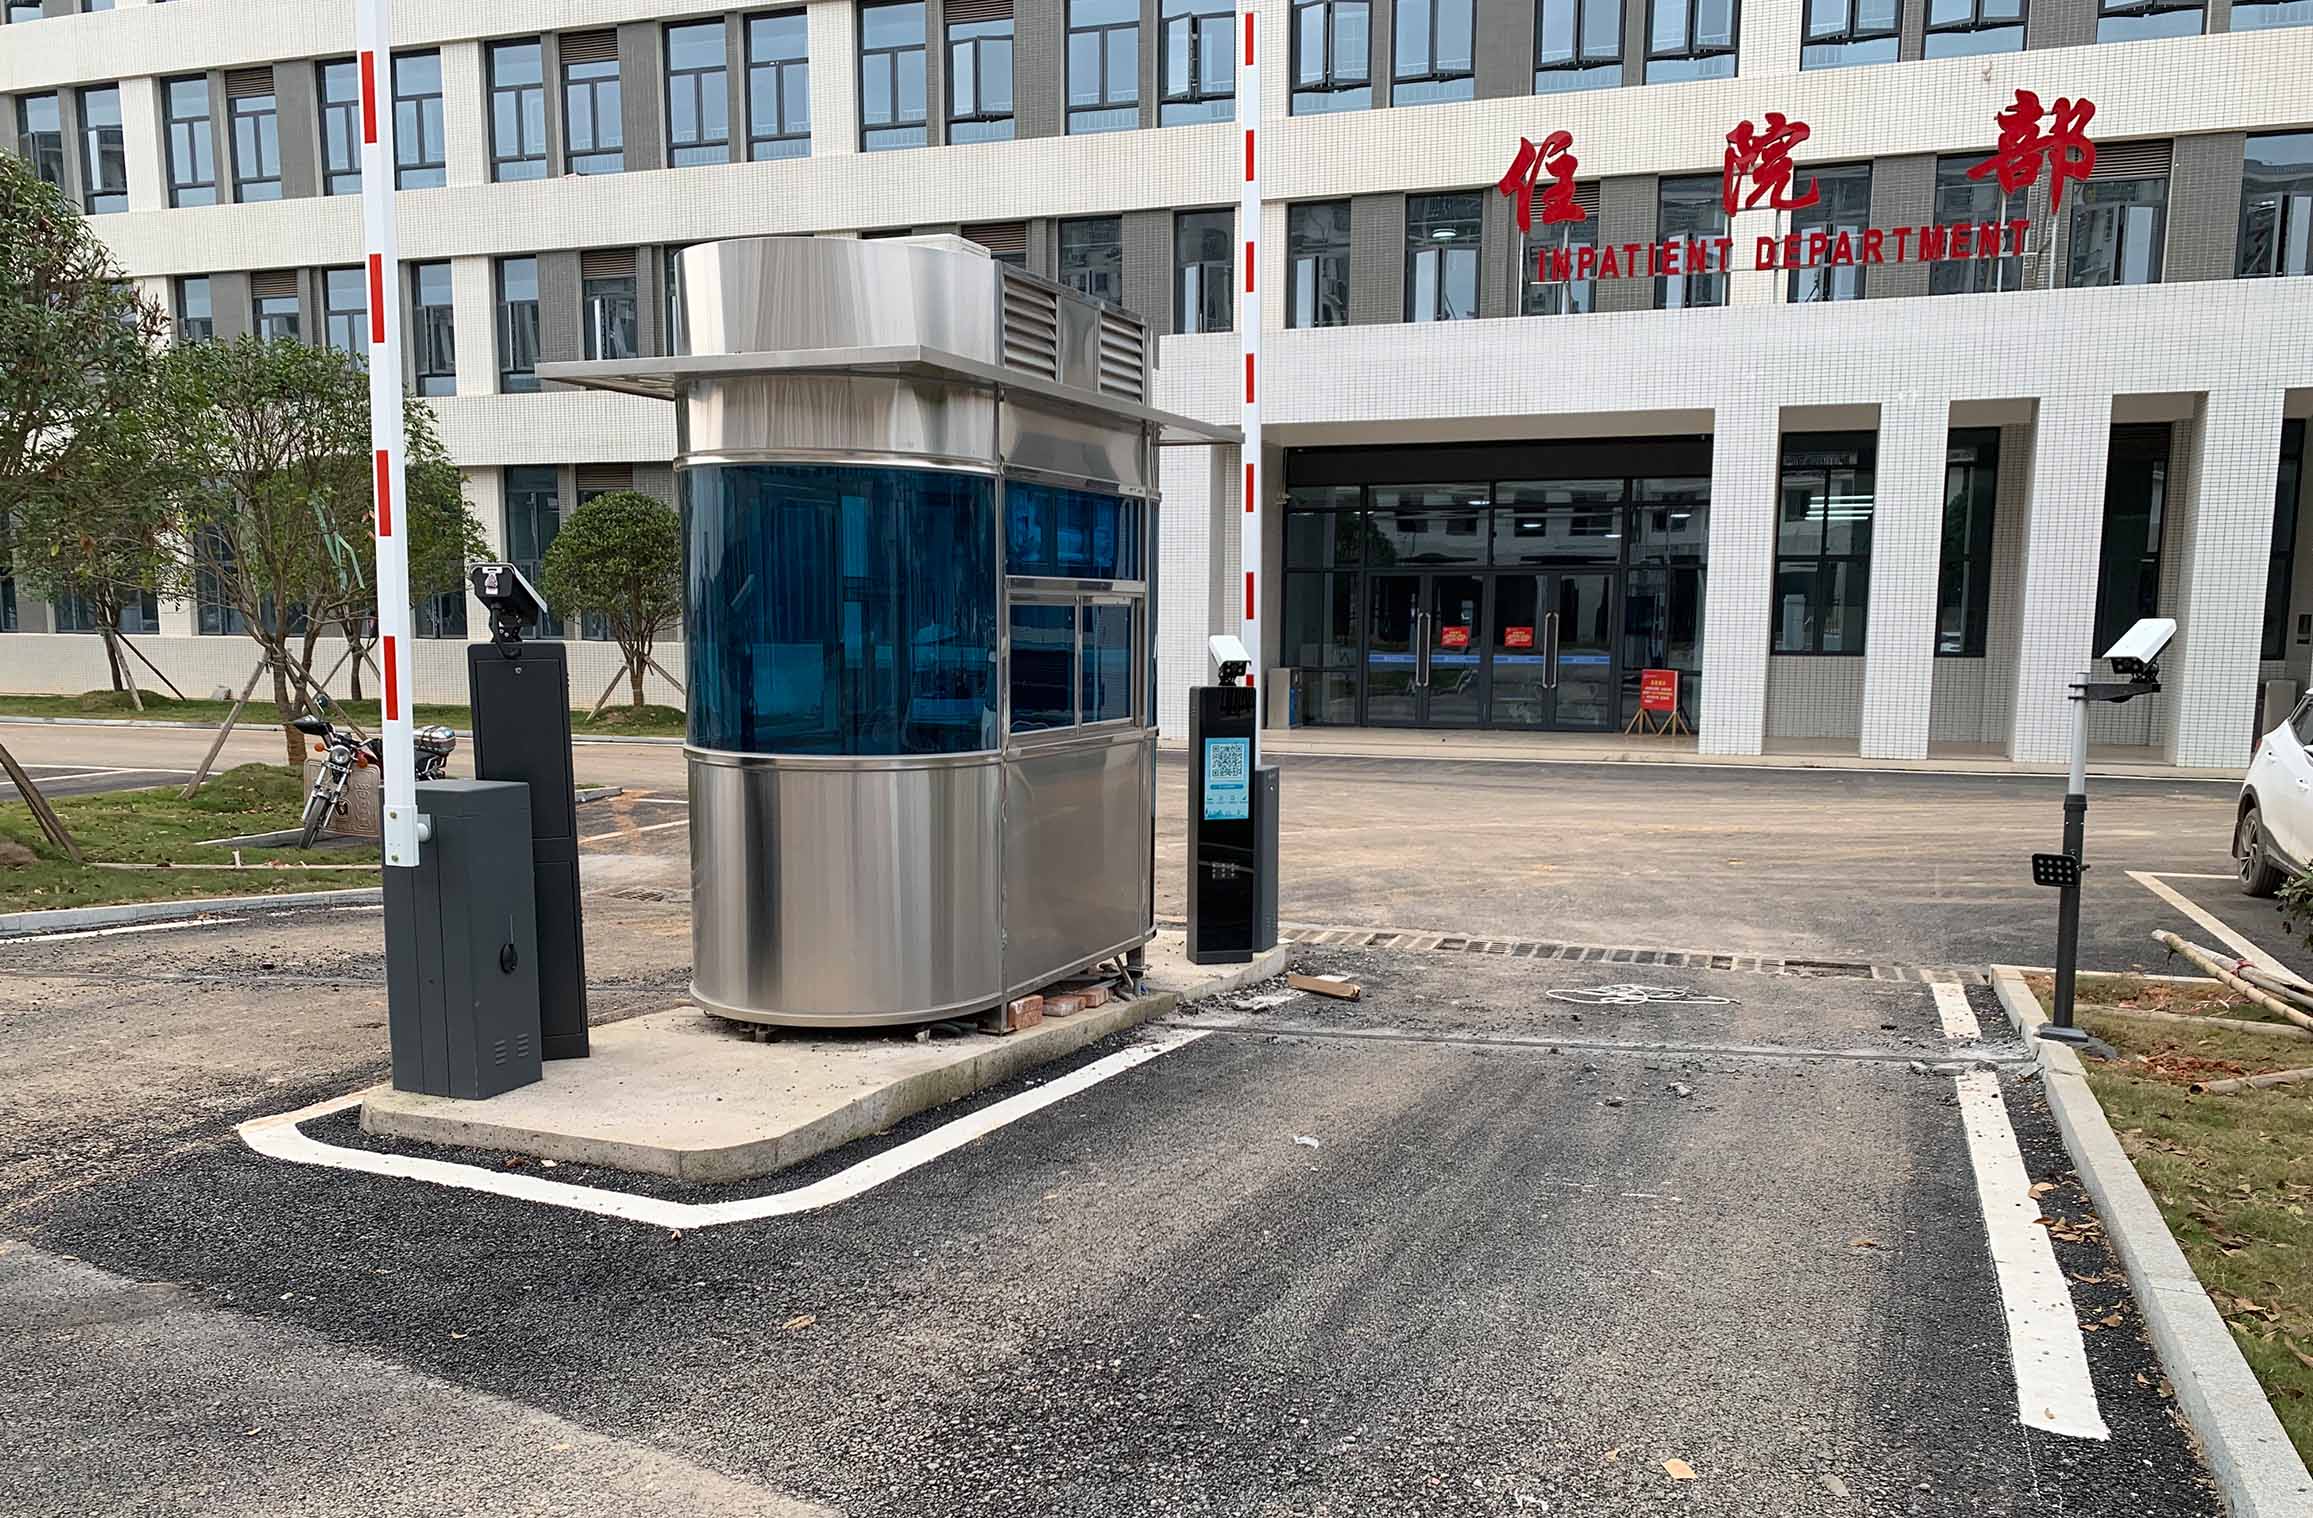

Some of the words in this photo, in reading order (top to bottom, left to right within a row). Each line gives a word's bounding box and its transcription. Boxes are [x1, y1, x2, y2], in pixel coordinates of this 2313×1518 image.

[1498, 89, 2096, 233] 住院部
[1538, 239, 1733, 282] INPATIENT
[1755, 220, 2031, 271] DEPARTMENT
